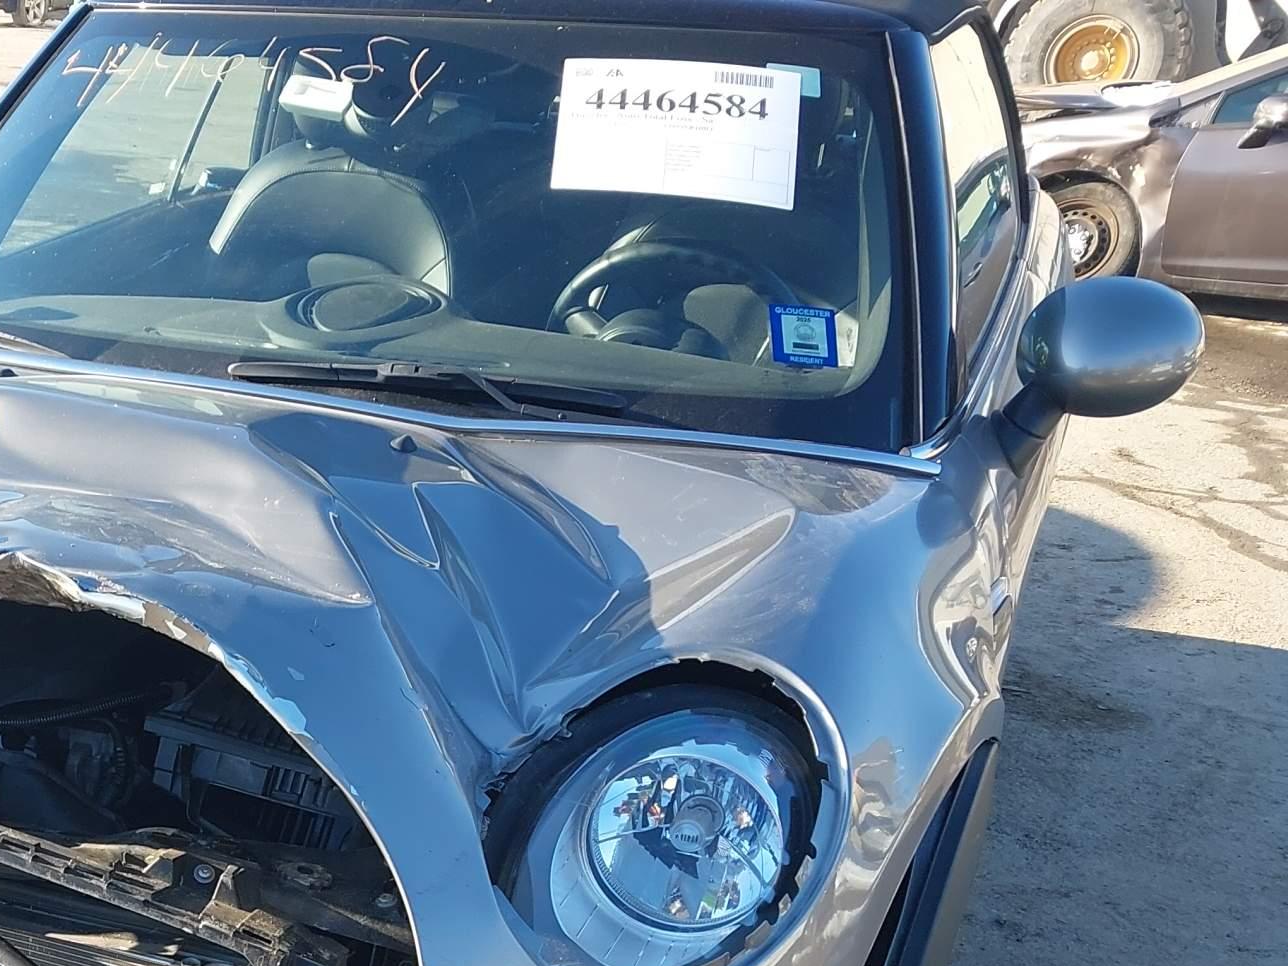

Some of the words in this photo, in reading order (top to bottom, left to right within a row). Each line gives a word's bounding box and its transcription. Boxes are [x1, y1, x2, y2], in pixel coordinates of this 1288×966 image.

[585, 88, 768, 120] 44464584
[774, 306, 831, 317] GLOUCESTER
[790, 356, 823, 365] RESIDENT
